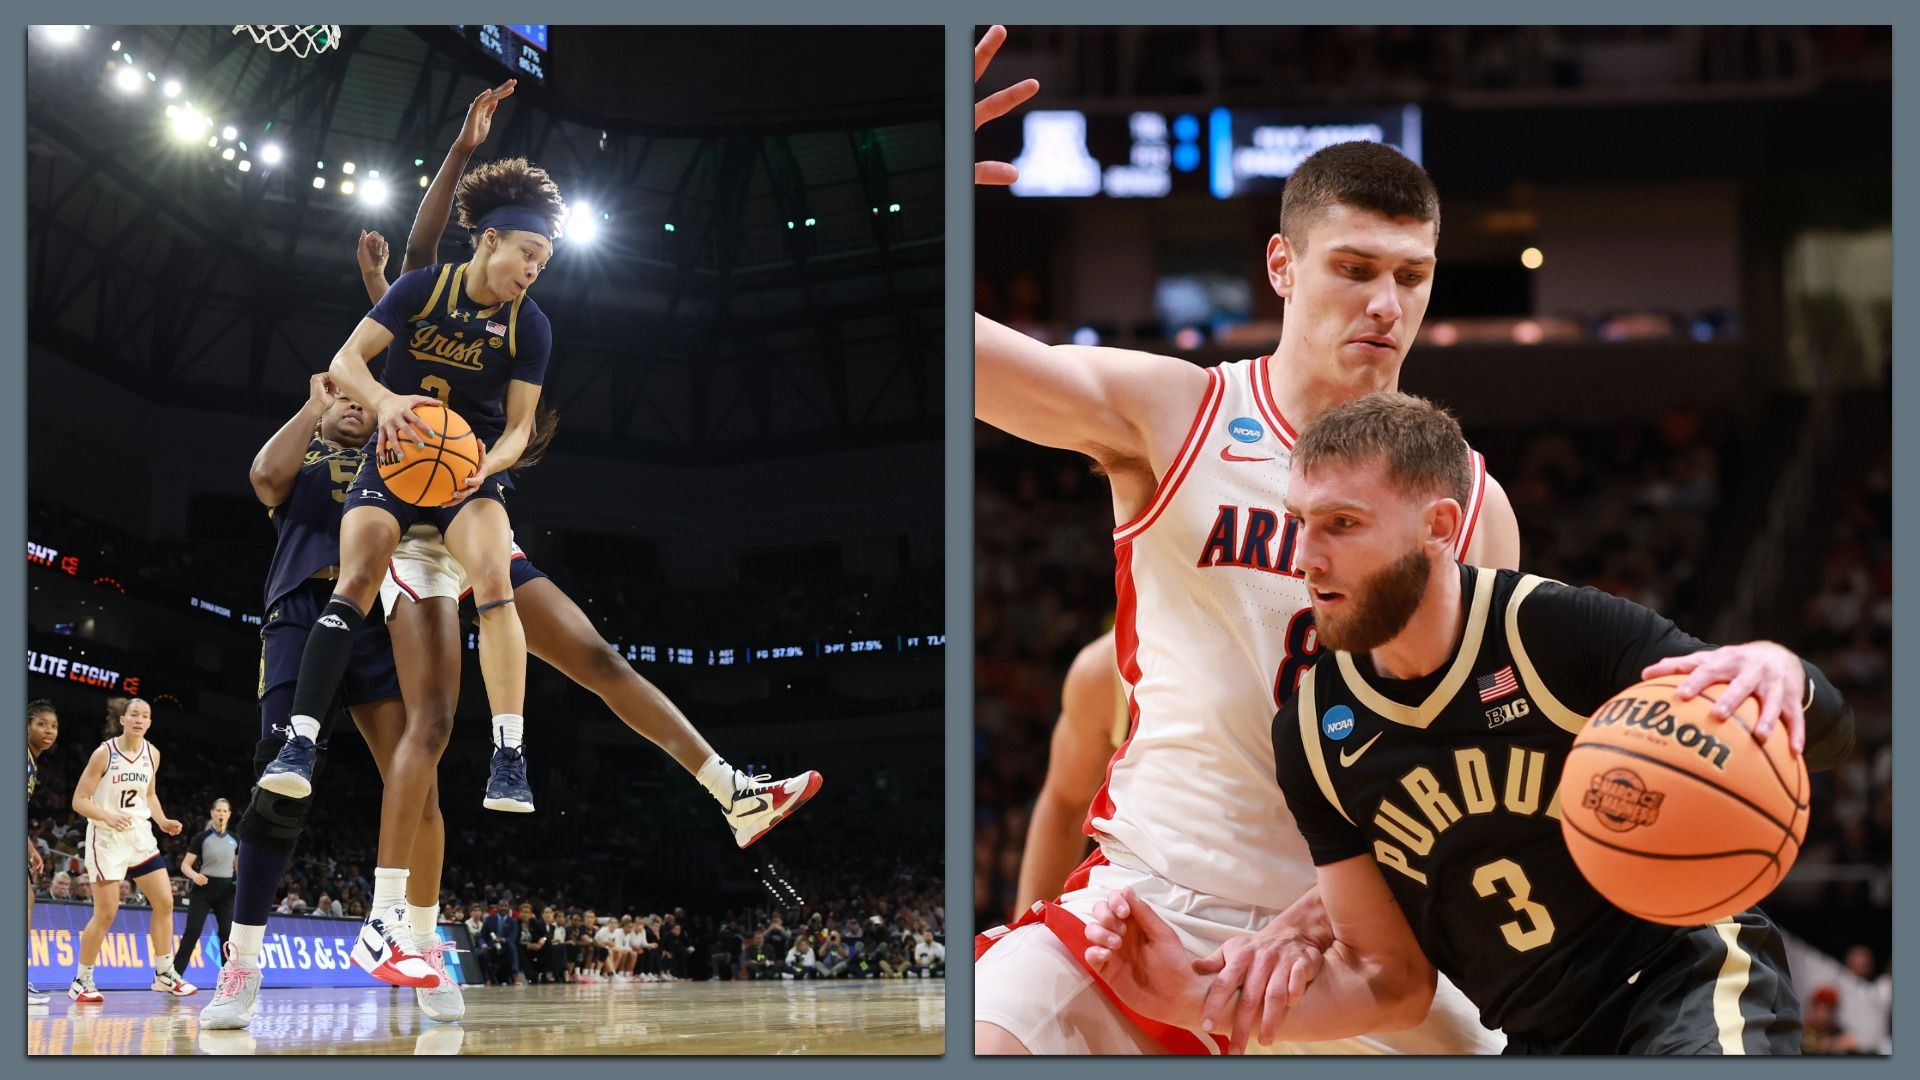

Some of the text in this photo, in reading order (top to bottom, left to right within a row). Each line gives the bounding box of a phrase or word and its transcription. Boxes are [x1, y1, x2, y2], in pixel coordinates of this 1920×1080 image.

[410, 325, 486, 363] Irish
[1232, 426, 1261, 437] NCAA
[328, 459, 359, 503] 5
[1197, 505, 1305, 578] ARI
[756, 650, 768, 658] FG
[1274, 607, 1321, 709] 8
[70, 662, 119, 688] EIGHT
[1327, 718, 1353, 734] NCAA
[1485, 698, 1530, 729] BIG
[1592, 696, 1732, 770] Wilson
[112, 773, 149, 784] UCONN
[120, 789, 138, 808] 12
[1472, 858, 1556, 952] 3
[28, 929, 74, 967] N'S
[293, 936, 312, 970] 3
[314, 937, 336, 970] &
[334, 938, 351, 970] 5
